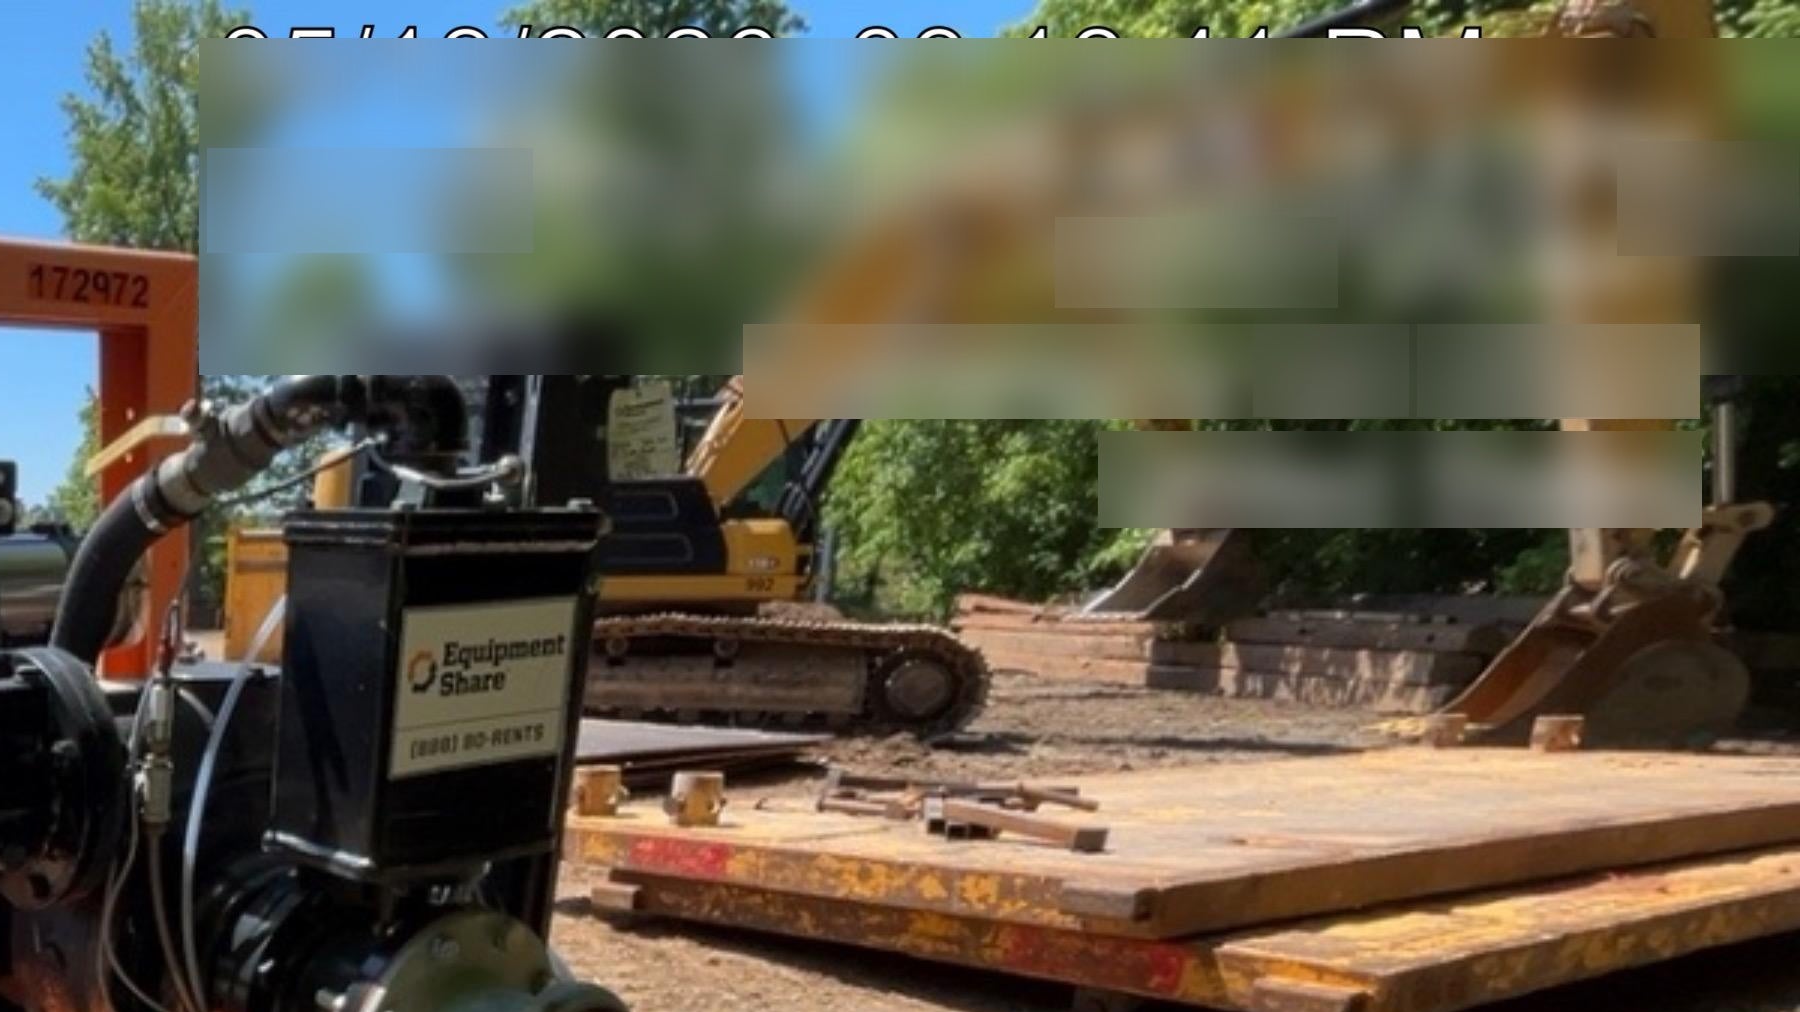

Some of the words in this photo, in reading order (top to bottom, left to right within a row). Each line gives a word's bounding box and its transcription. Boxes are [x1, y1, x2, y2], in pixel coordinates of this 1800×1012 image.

[29, 264, 150, 309] 172972
[443, 634, 565, 670] Equipment
[439, 671, 506, 697] Share
